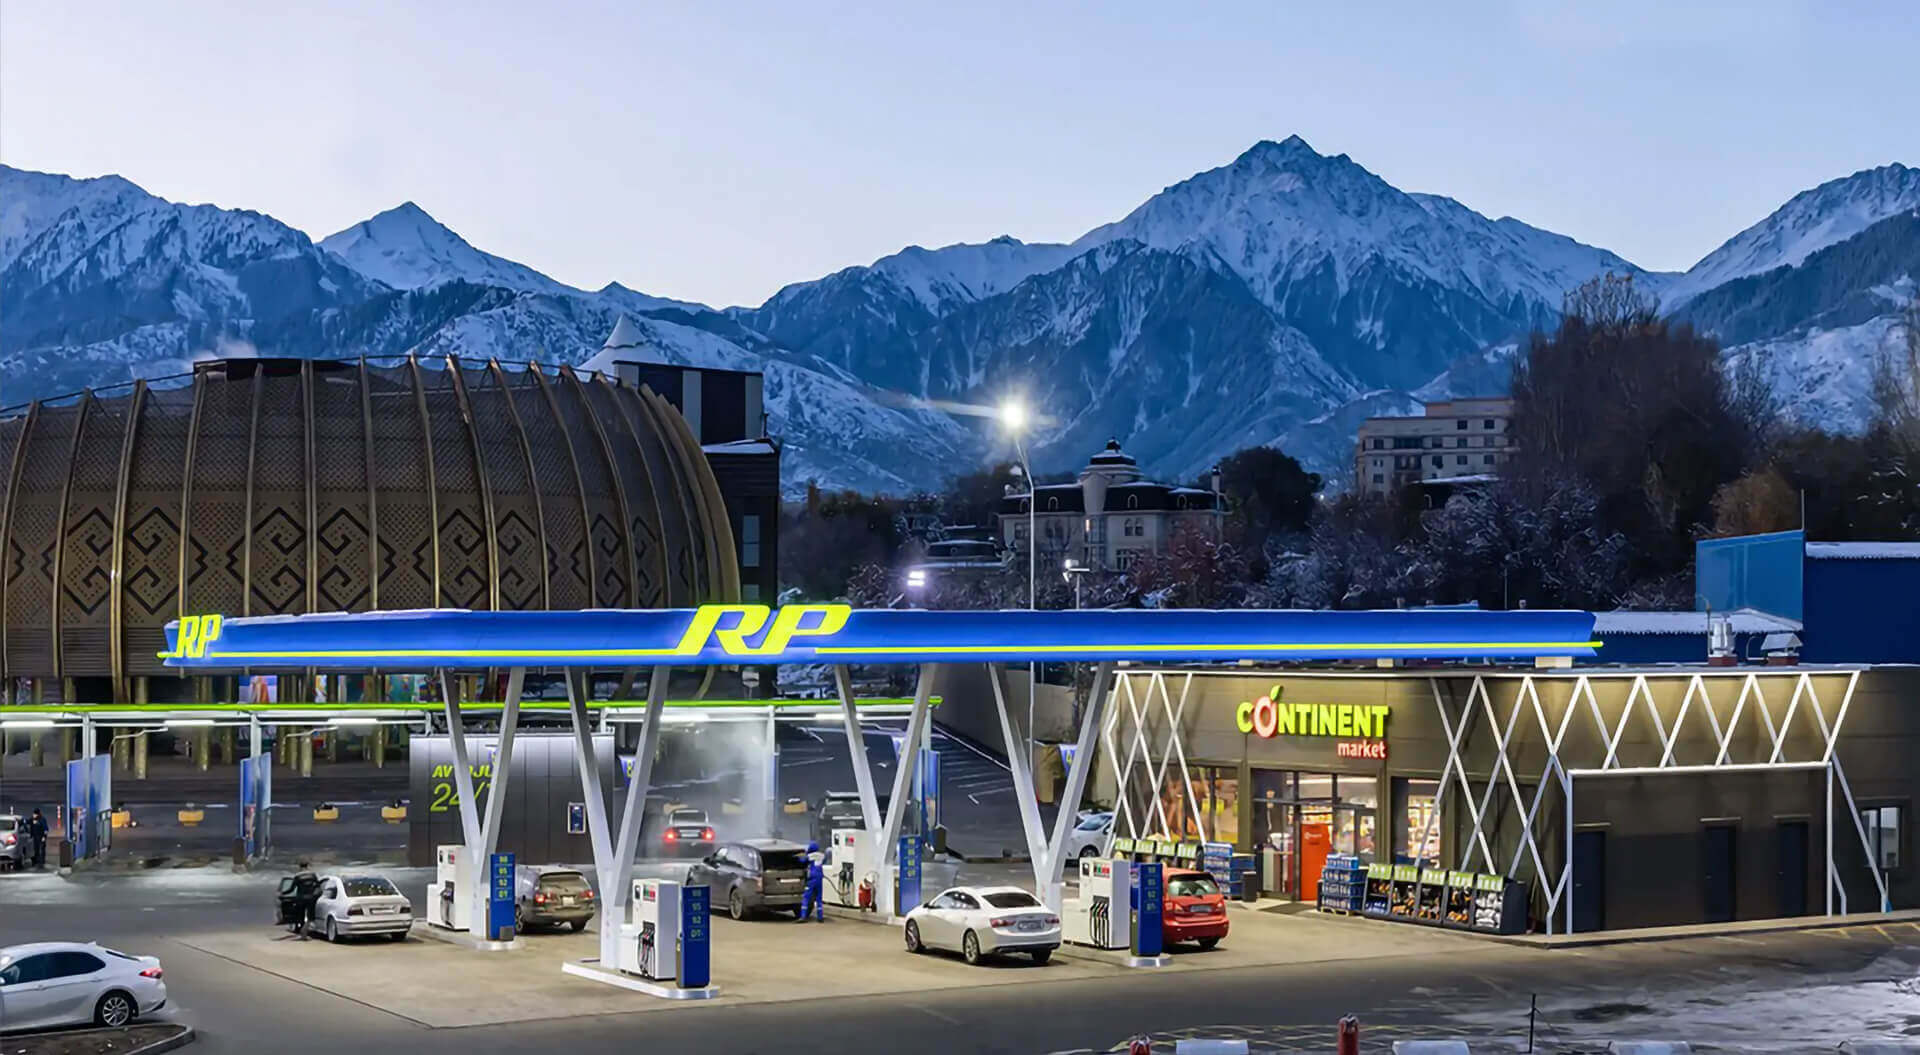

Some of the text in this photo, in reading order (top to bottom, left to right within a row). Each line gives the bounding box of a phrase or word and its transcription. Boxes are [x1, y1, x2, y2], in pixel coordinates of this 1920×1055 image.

[175, 614, 223, 658] RP
[676, 604, 852, 656] RP
[1236, 695, 1389, 739] CONTINENT
[1337, 739, 1387, 759] market
[429, 781, 492, 812] 24/
